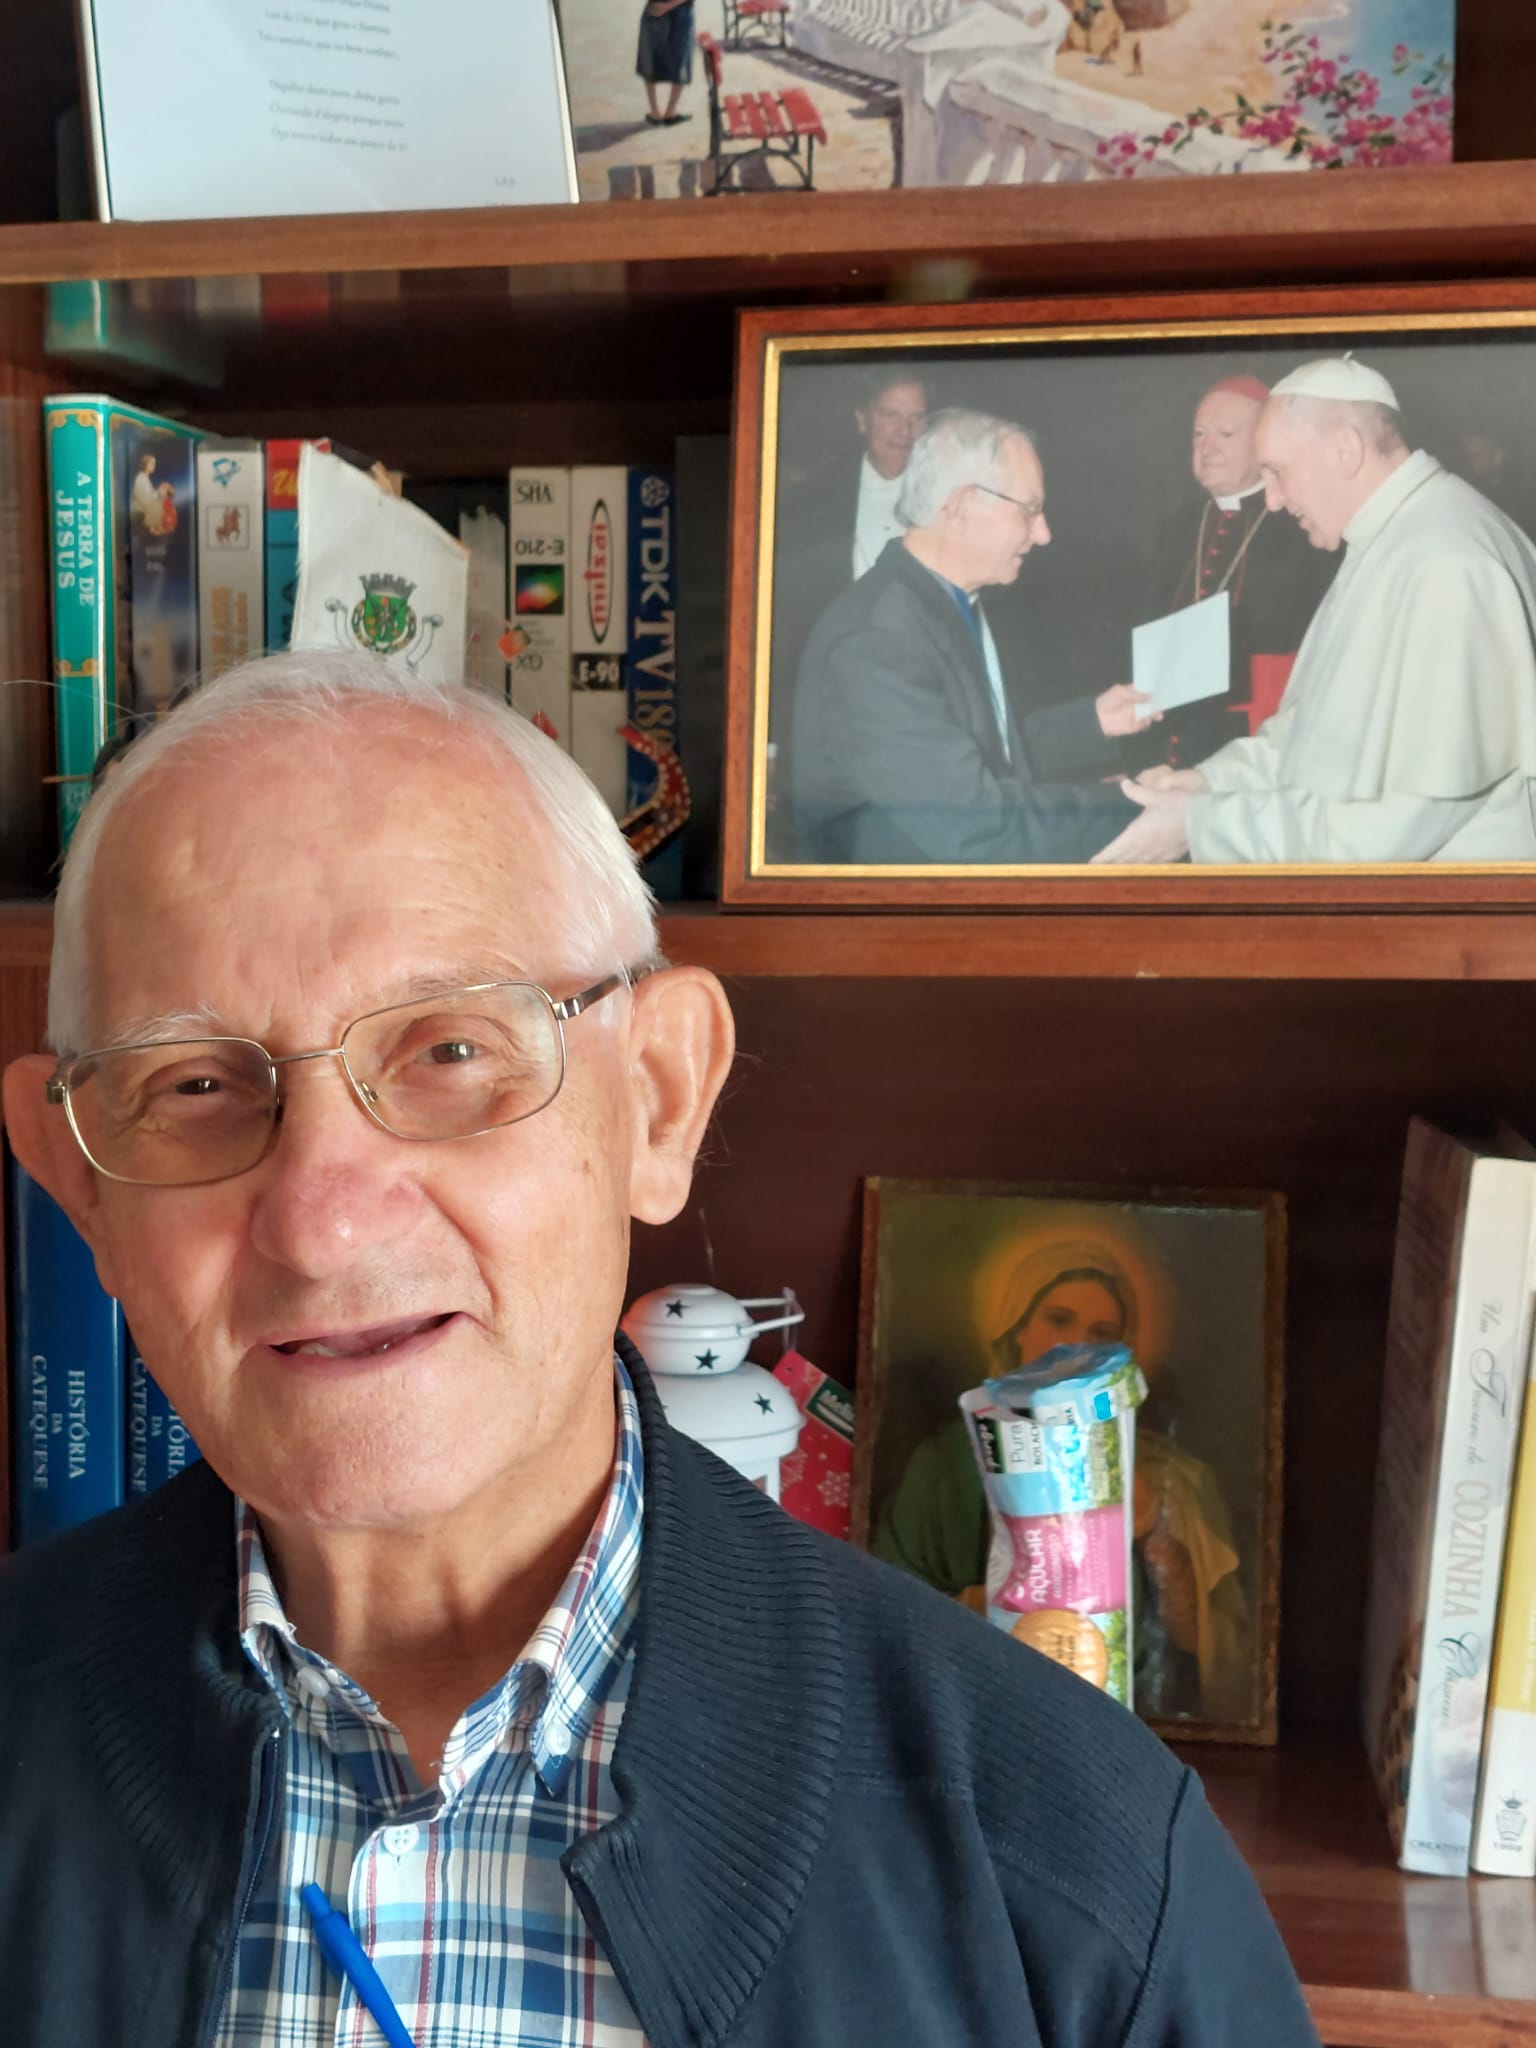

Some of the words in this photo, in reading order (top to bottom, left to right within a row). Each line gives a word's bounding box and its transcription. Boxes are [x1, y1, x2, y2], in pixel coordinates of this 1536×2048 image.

[77, 471, 92, 487] A
[516, 484, 552, 502] VHS
[55, 489, 75, 589] JESUS
[77, 495, 94, 569] TERRA
[515, 539, 565, 556] E-210
[640, 505, 670, 604] TDK
[79, 577, 95, 607] DE
[579, 660, 620, 682] E-90
[30, 1354, 49, 1490] CATEQUESE
[52, 1413, 64, 1435] DA
[68, 1369, 91, 1480] HISTÓRIA
[151, 1415, 163, 1437] DA
[1008, 1423, 1026, 1465] Pura
[1442, 1479, 1491, 1619] COZINHA
